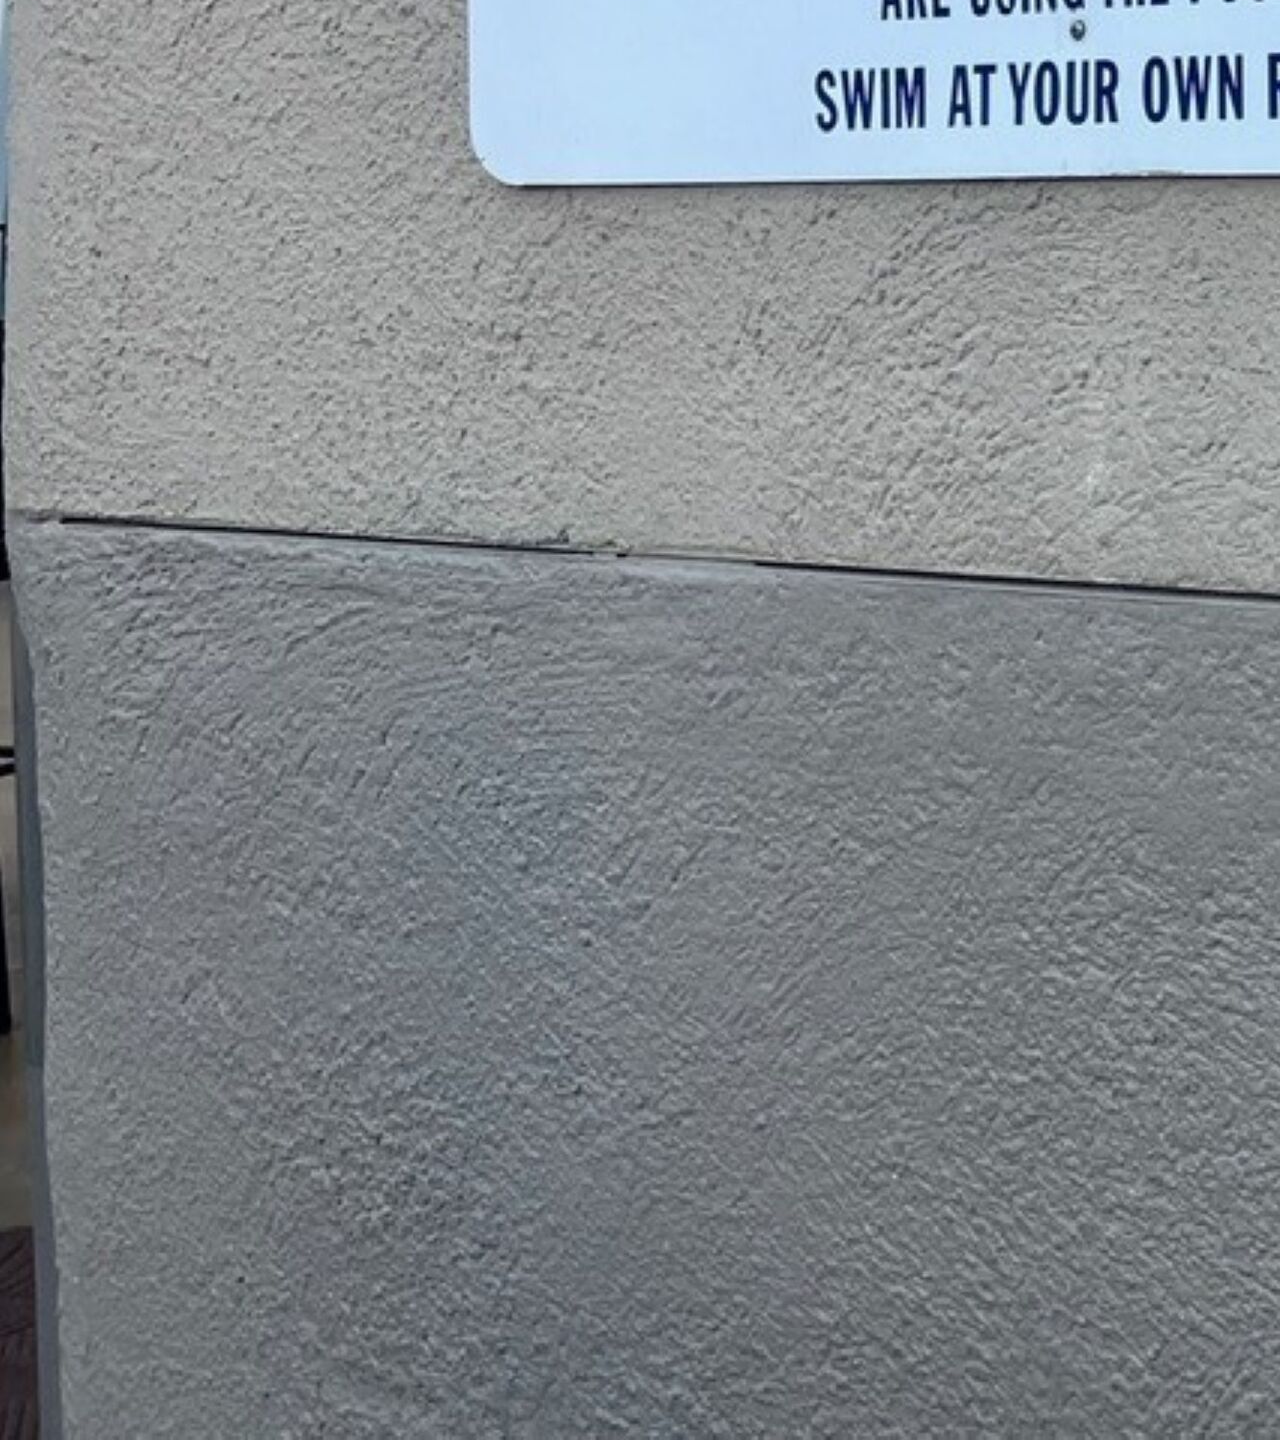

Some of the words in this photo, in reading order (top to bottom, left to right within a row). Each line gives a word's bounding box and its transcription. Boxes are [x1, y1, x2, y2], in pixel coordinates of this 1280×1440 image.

[814, 65, 928, 134] SWIM
[948, 63, 999, 128] AT
[1007, 58, 1120, 127] YOUR
[1142, 53, 1246, 124] OWN
